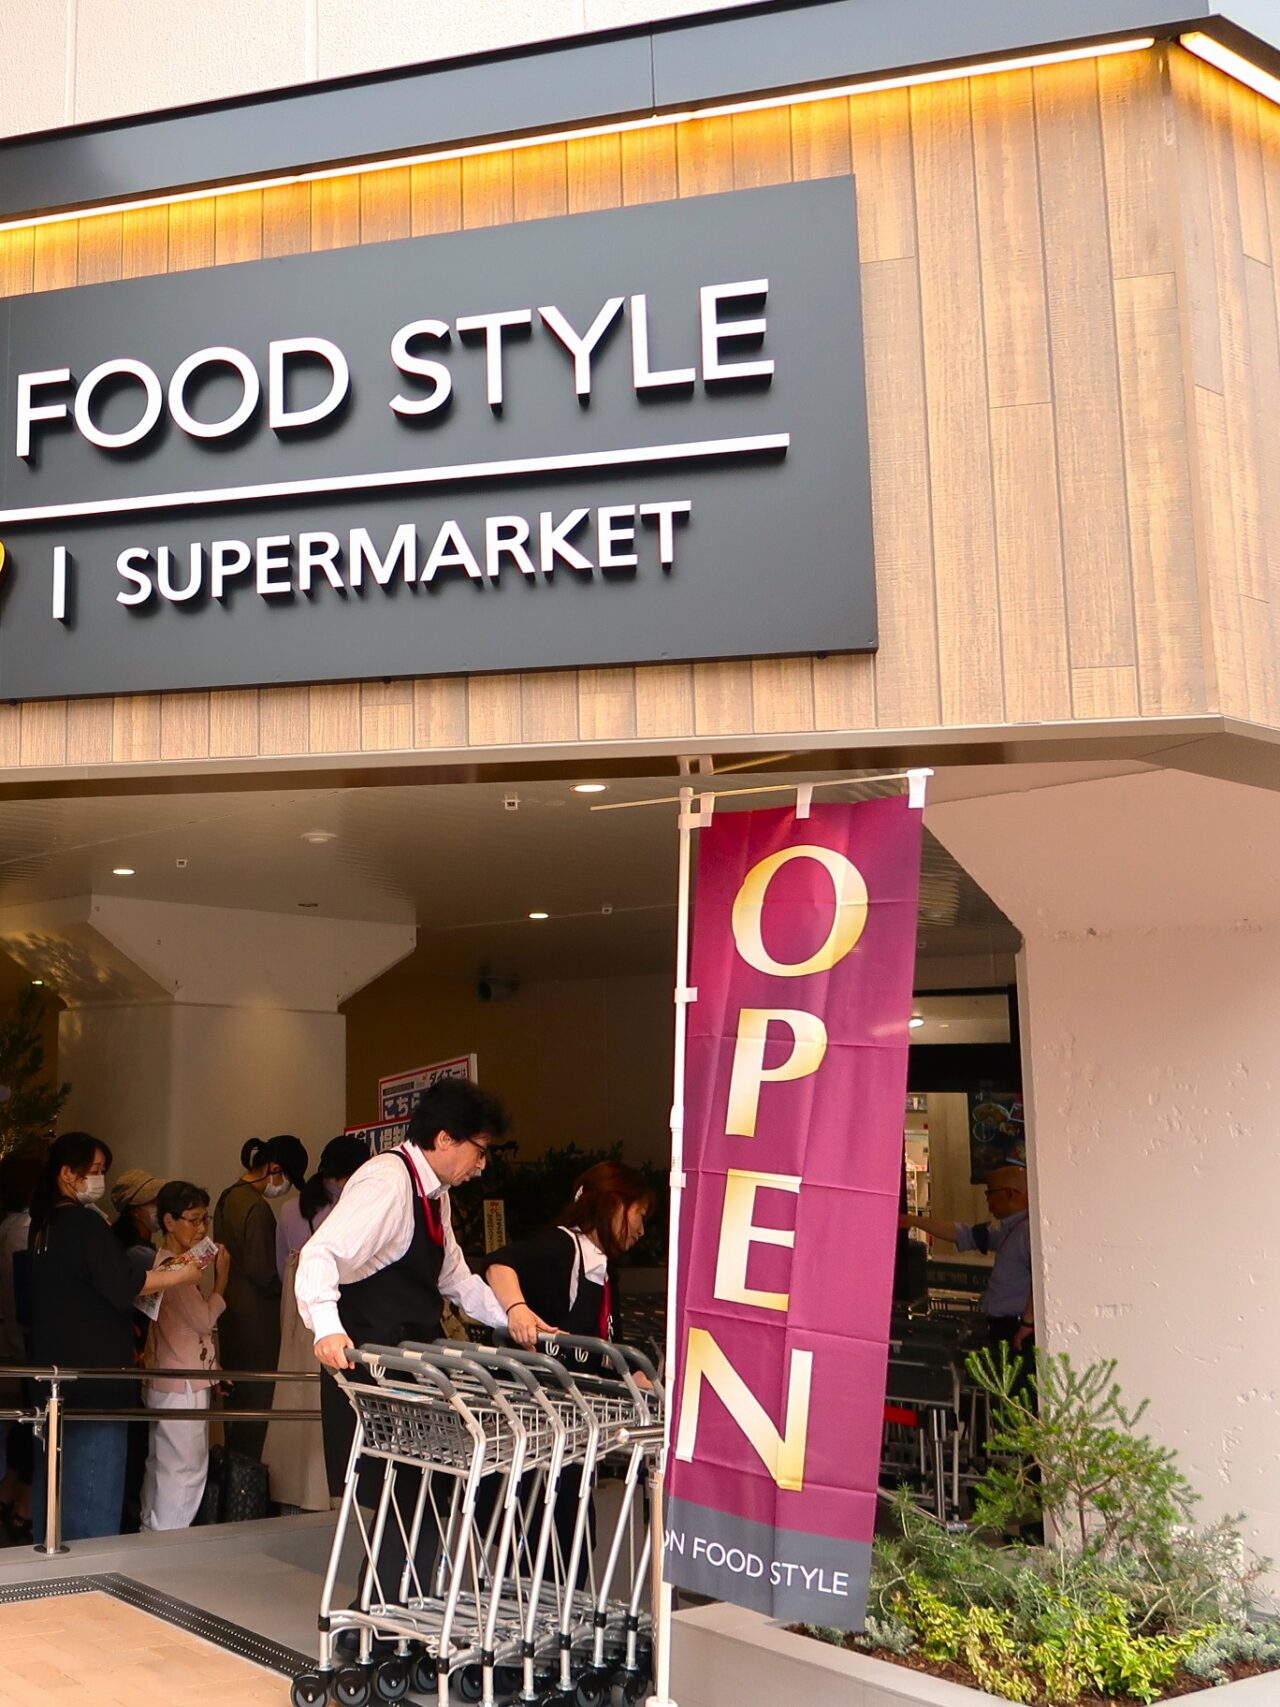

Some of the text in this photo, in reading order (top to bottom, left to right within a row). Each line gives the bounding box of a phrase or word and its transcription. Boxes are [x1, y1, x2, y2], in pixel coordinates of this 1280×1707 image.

[16, 336, 350, 458] FOOD
[389, 279, 775, 416] STYLE
[115, 501, 692, 605] SUPERMARKET
[675, 844, 869, 1493] OPEN
[692, 1537, 764, 1578] FOOD
[770, 1561, 849, 1596] STYLE
